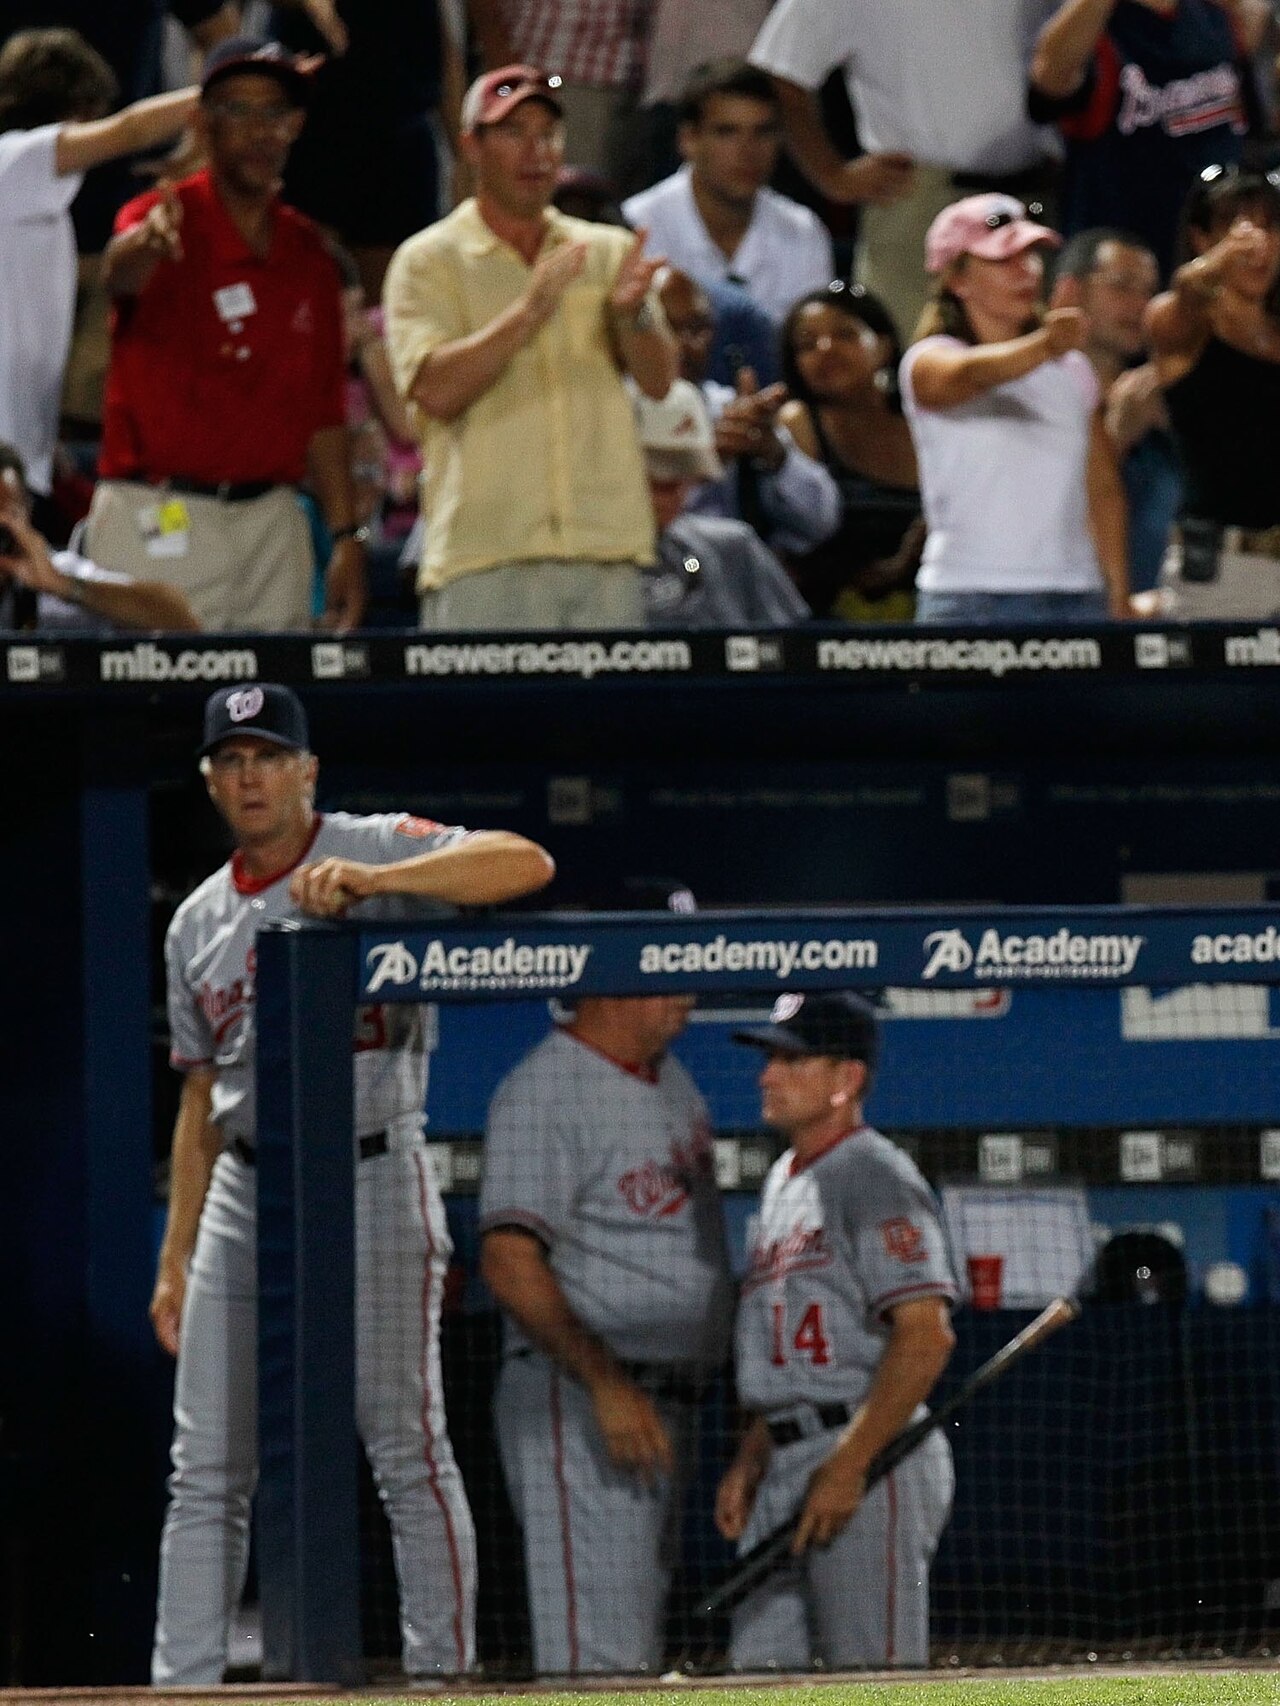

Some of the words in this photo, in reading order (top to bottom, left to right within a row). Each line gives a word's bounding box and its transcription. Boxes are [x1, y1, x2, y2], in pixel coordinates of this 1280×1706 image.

[100, 642, 258, 682] mlb.com
[405, 641, 691, 679] neweracap.com
[818, 638, 1100, 676] neweracap.com
[421, 937, 591, 983] Academy
[640, 934, 878, 979] academy.com
[976, 928, 1142, 974] Academy
[772, 1302, 830, 1367] 14
